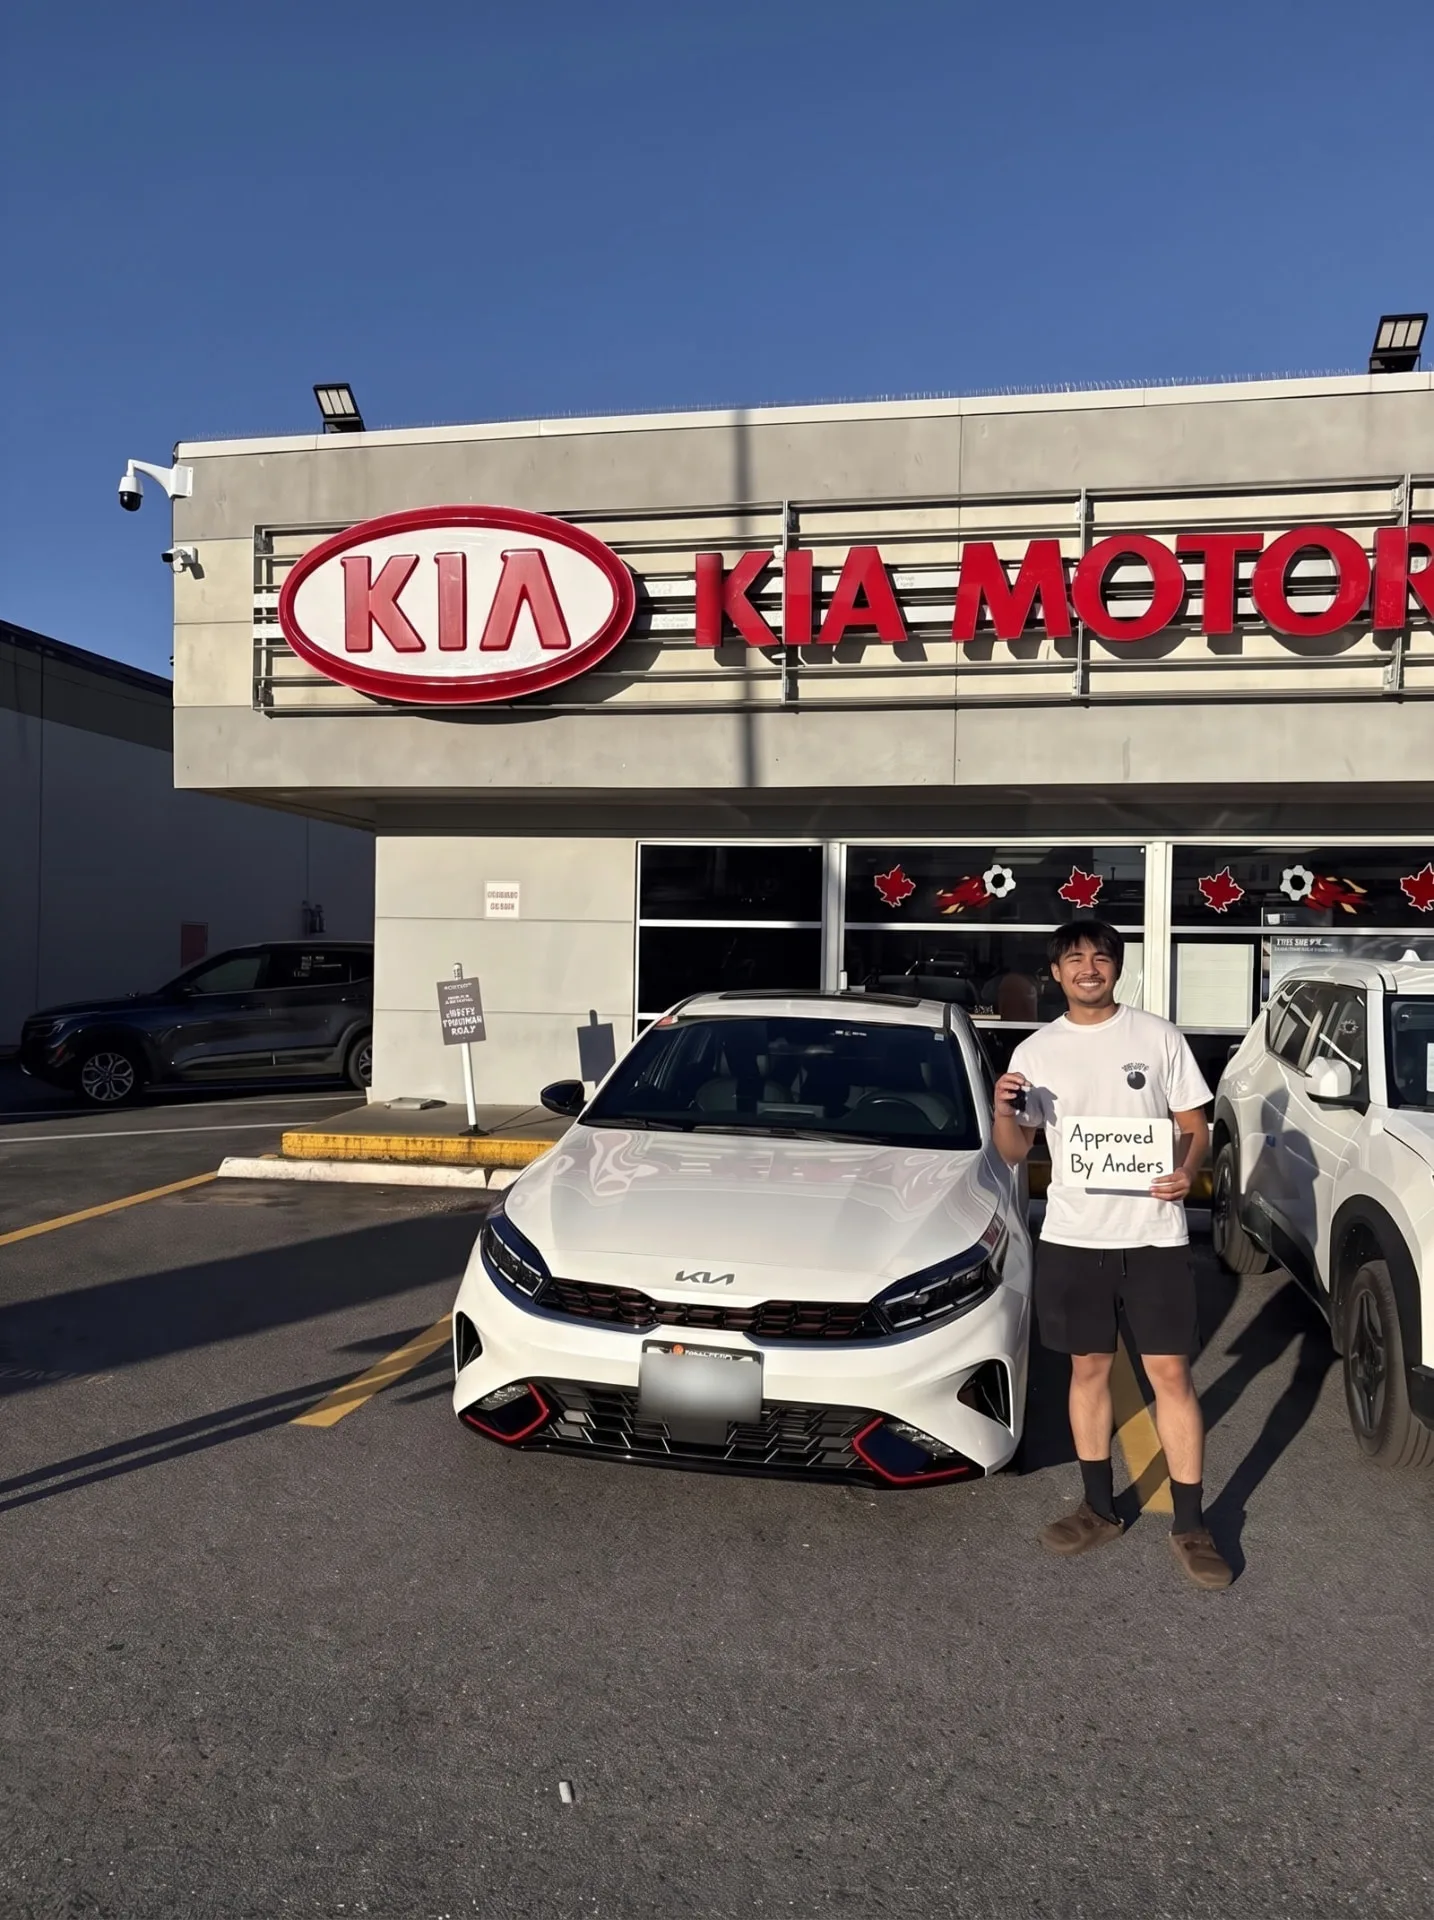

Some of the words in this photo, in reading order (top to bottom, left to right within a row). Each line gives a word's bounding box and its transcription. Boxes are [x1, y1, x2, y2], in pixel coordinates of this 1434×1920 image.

[340, 548, 572, 653] KIA
[695, 545, 908, 648] KIA
[951, 525, 1434, 643] MOTOR
[1069, 1123, 1154, 1151] Approved
[1070, 1153, 1094, 1180] By
[1102, 1153, 1164, 1174] Anders
[675, 1270, 735, 1286] KIA
